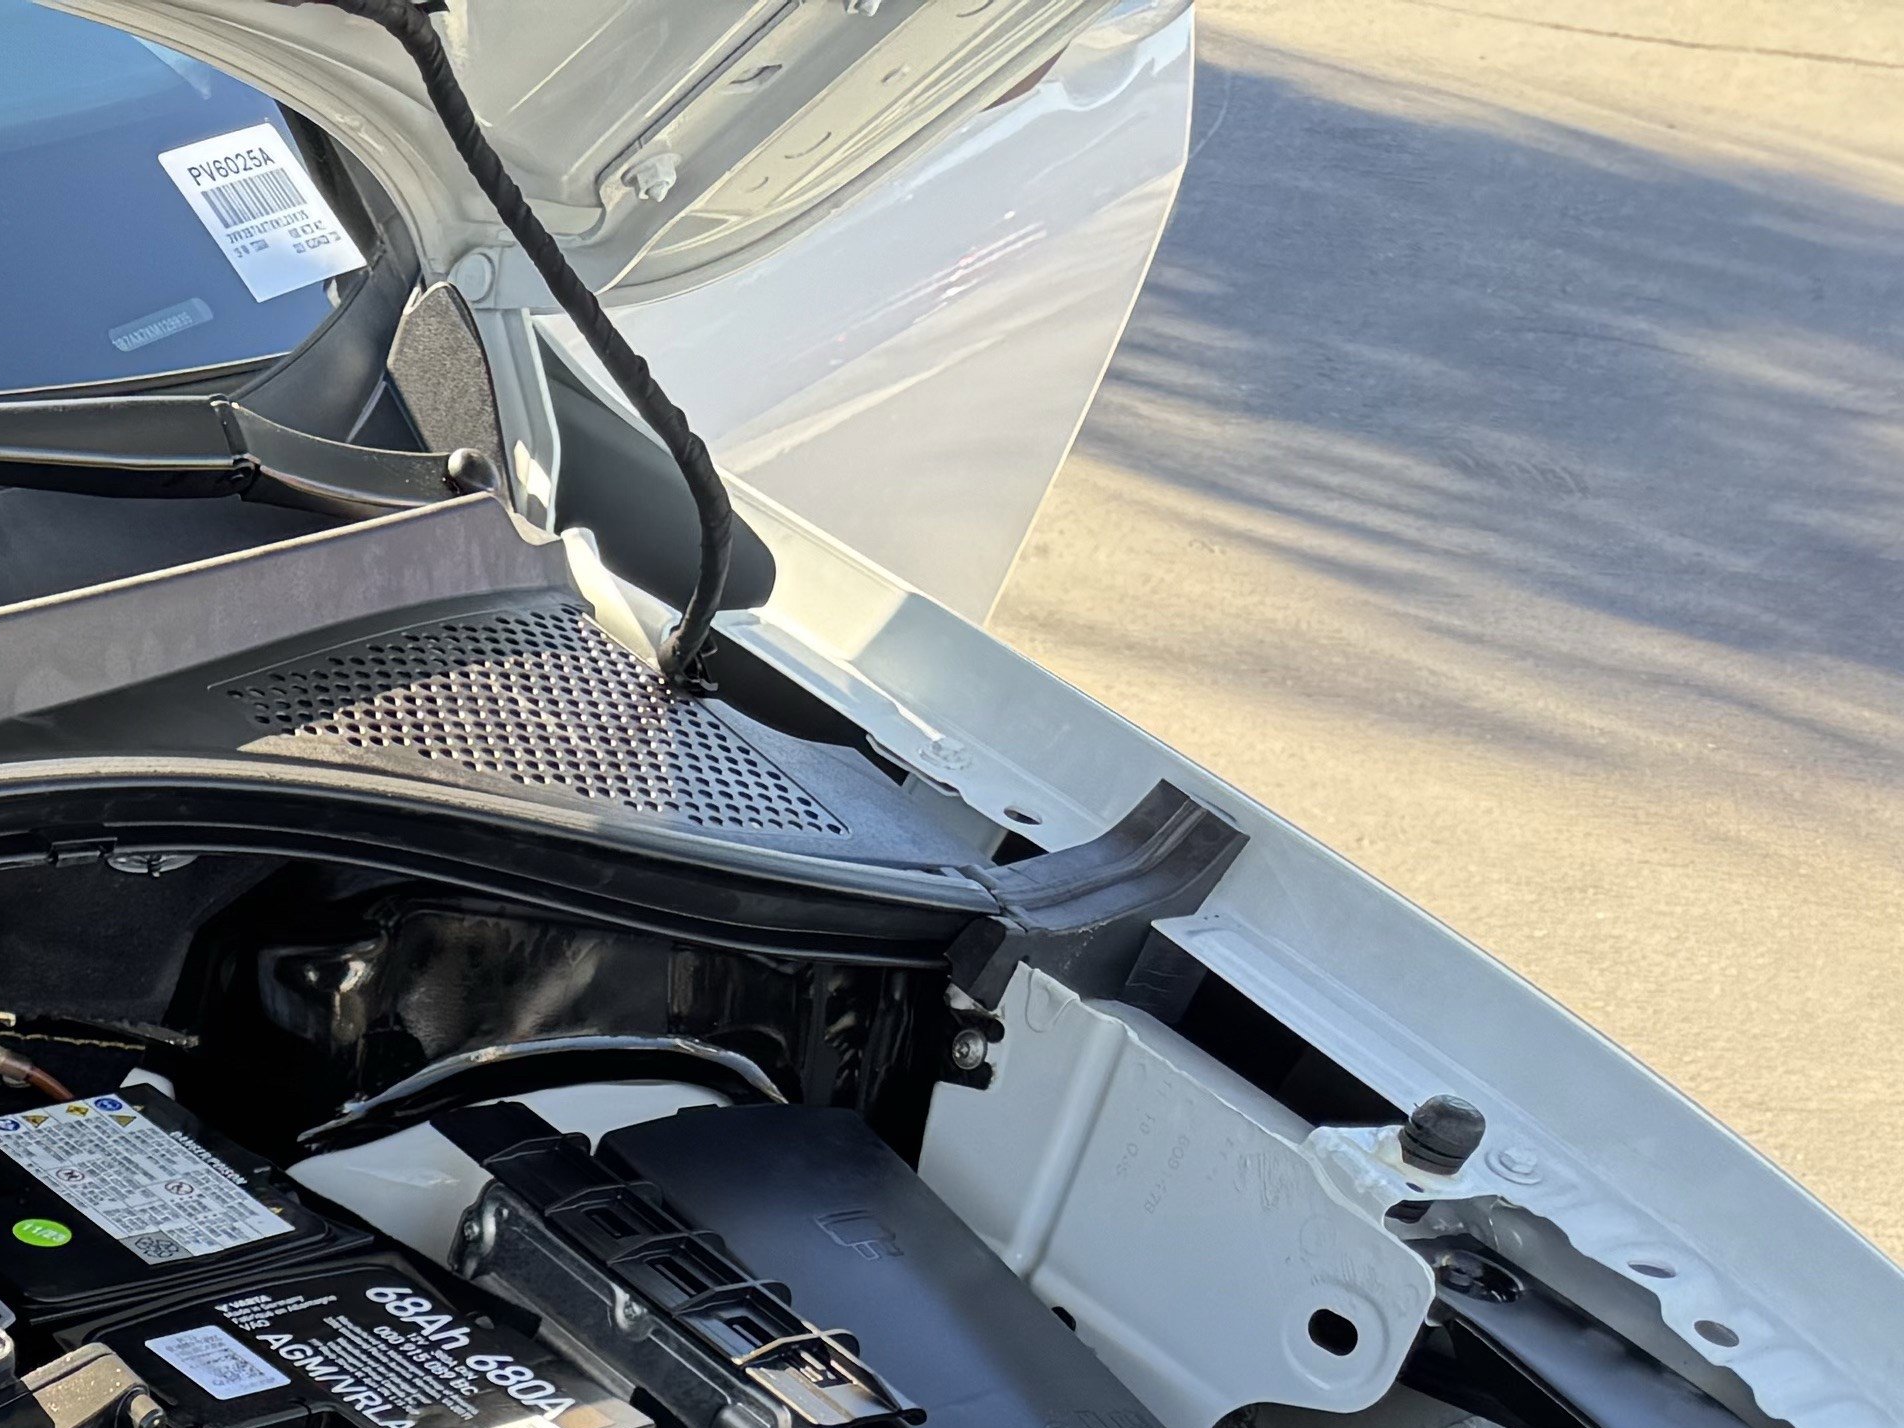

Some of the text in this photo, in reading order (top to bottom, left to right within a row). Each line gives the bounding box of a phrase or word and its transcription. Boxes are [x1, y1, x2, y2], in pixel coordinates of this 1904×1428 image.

[187, 147, 274, 186] PV6025A
[366, 1287, 469, 1349] 68Ah
[465, 1351, 576, 1417] 680A
[398, 1342, 431, 1362] 915
